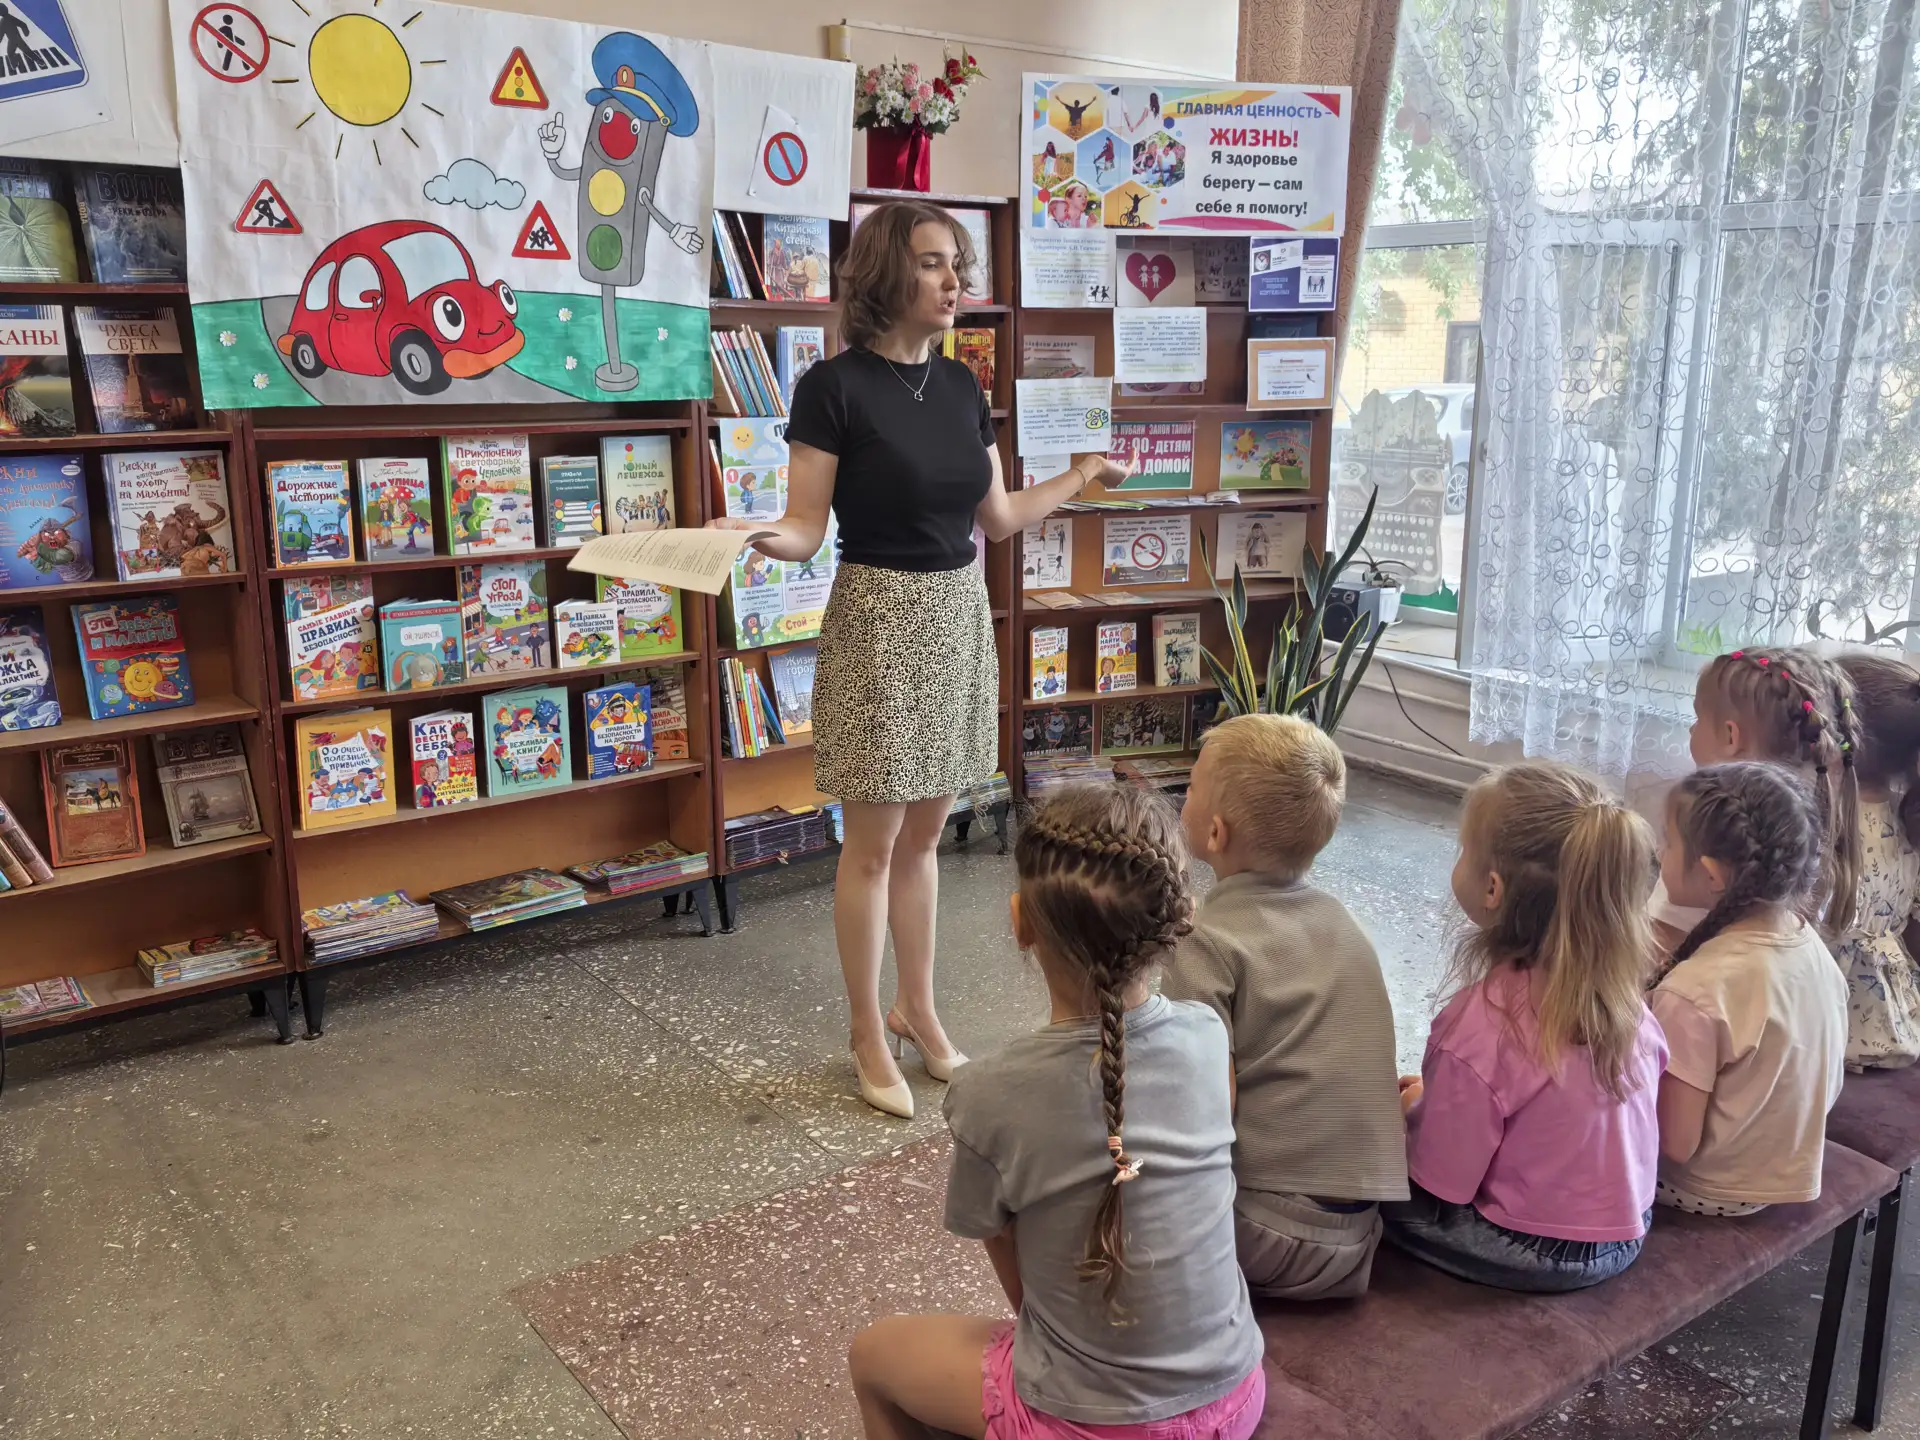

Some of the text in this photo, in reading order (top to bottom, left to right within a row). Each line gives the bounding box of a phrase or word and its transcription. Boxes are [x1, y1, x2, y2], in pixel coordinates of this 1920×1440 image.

[1176, 102, 1243, 117] ГЛАВНАЯ
[1246, 104, 1322, 119] ЦЕННОСТЬ
[1209, 127, 1299, 148] ЖИЗНЬ!
[1211, 150, 1298, 168] Я здоровье
[1203, 174, 1255, 192] берегу
[1274, 180, 1303, 190] сам
[1195, 199, 1308, 218] себе я помогу!
[773, 222, 822, 236] Китайская
[785, 235, 811, 246] стена
[98, 323, 161, 337] ЧУДЕСА
[107, 338, 160, 351] СВЕТА
[1143, 455, 1190, 476] ДОМОЙ
[617, 471, 665, 480] ПЕШЕХОД
[119, 491, 132, 499] на
[136, 484, 190, 499] мамонта!
[120, 479, 169, 491] на охоту
[277, 480, 338, 494] Дорожные
[289, 492, 339, 504] истории
[621, 589, 656, 598] ПРАВИЛА
[298, 608, 357, 632] САМЫЕ ГЛАВНЫЕ
[575, 612, 607, 622] Правила
[785, 616, 807, 630] Стой
[300, 616, 360, 644] ПРАВИЛА
[1100, 629, 1120, 638] КАК
[303, 627, 363, 652] БЕЗОПАСНОСТИ
[414, 723, 447, 737] КАК
[597, 729, 642, 740] БЕЗОПАСНОСТИ
[605, 724, 633, 733] ПРАВИЛА
[415, 734, 448, 744] ВЕСТИ
[614, 735, 636, 743] ДОРОГЕ
[415, 741, 448, 752] СЕБЯ
[516, 745, 542, 755] КНИГА
